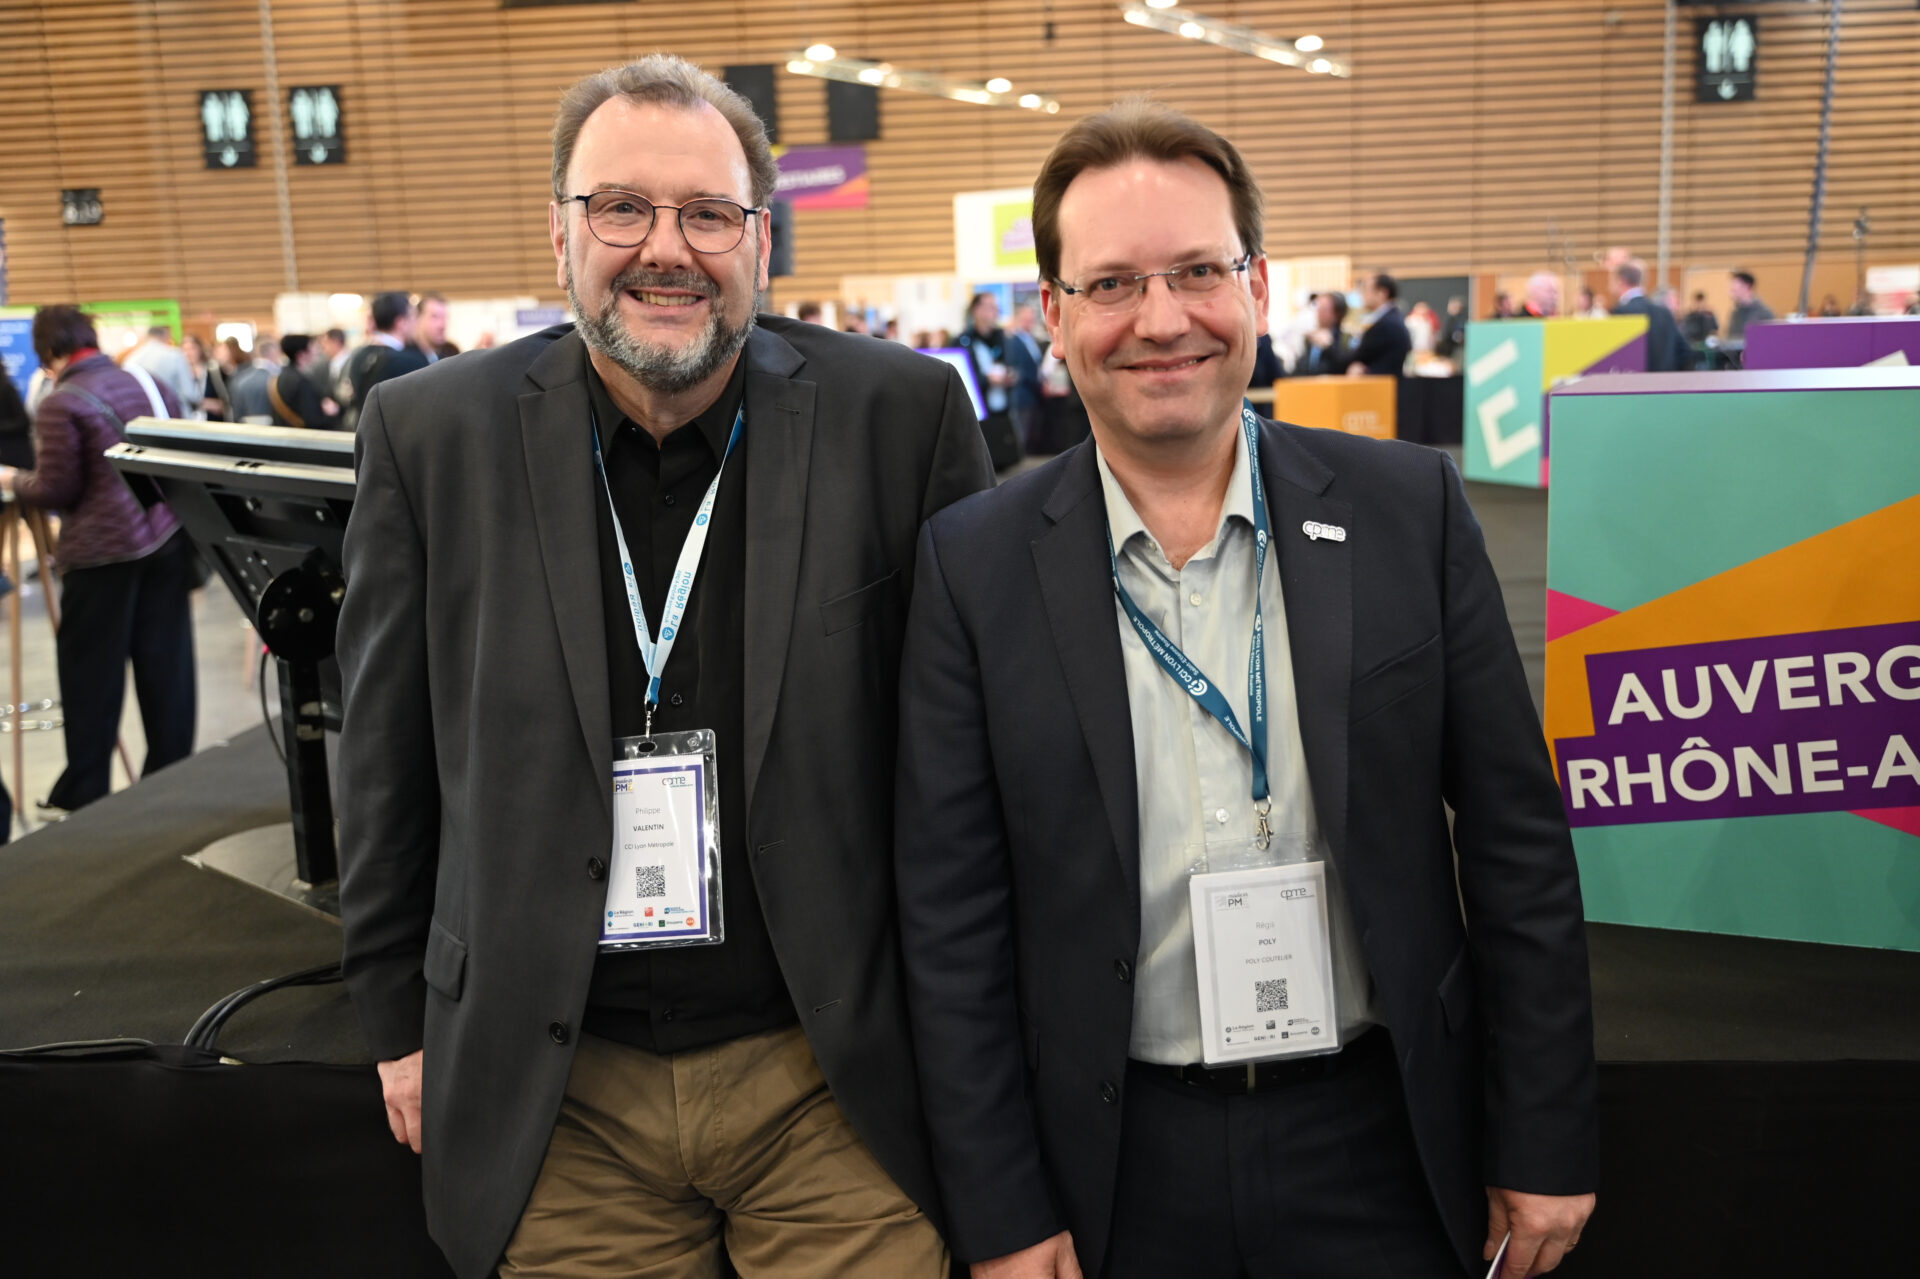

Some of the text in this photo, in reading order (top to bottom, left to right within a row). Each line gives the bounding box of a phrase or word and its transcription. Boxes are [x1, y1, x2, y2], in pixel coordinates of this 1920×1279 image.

[1132, 615, 1193, 683] CCI LYON MÉTROPOLE
[1608, 644, 1920, 726] AUVERG
[1566, 734, 1920, 810] RHÔNE-A
[635, 807, 661, 816] Philippe
[632, 824, 665, 832] VALENTIN
[634, 842, 647, 851] Lyon
[647, 841, 674, 850] Métropole
[1280, 887, 1307, 901] cpme
[1258, 937, 1277, 946] POLY
[1245, 954, 1293, 965] POLY COUTELIER
